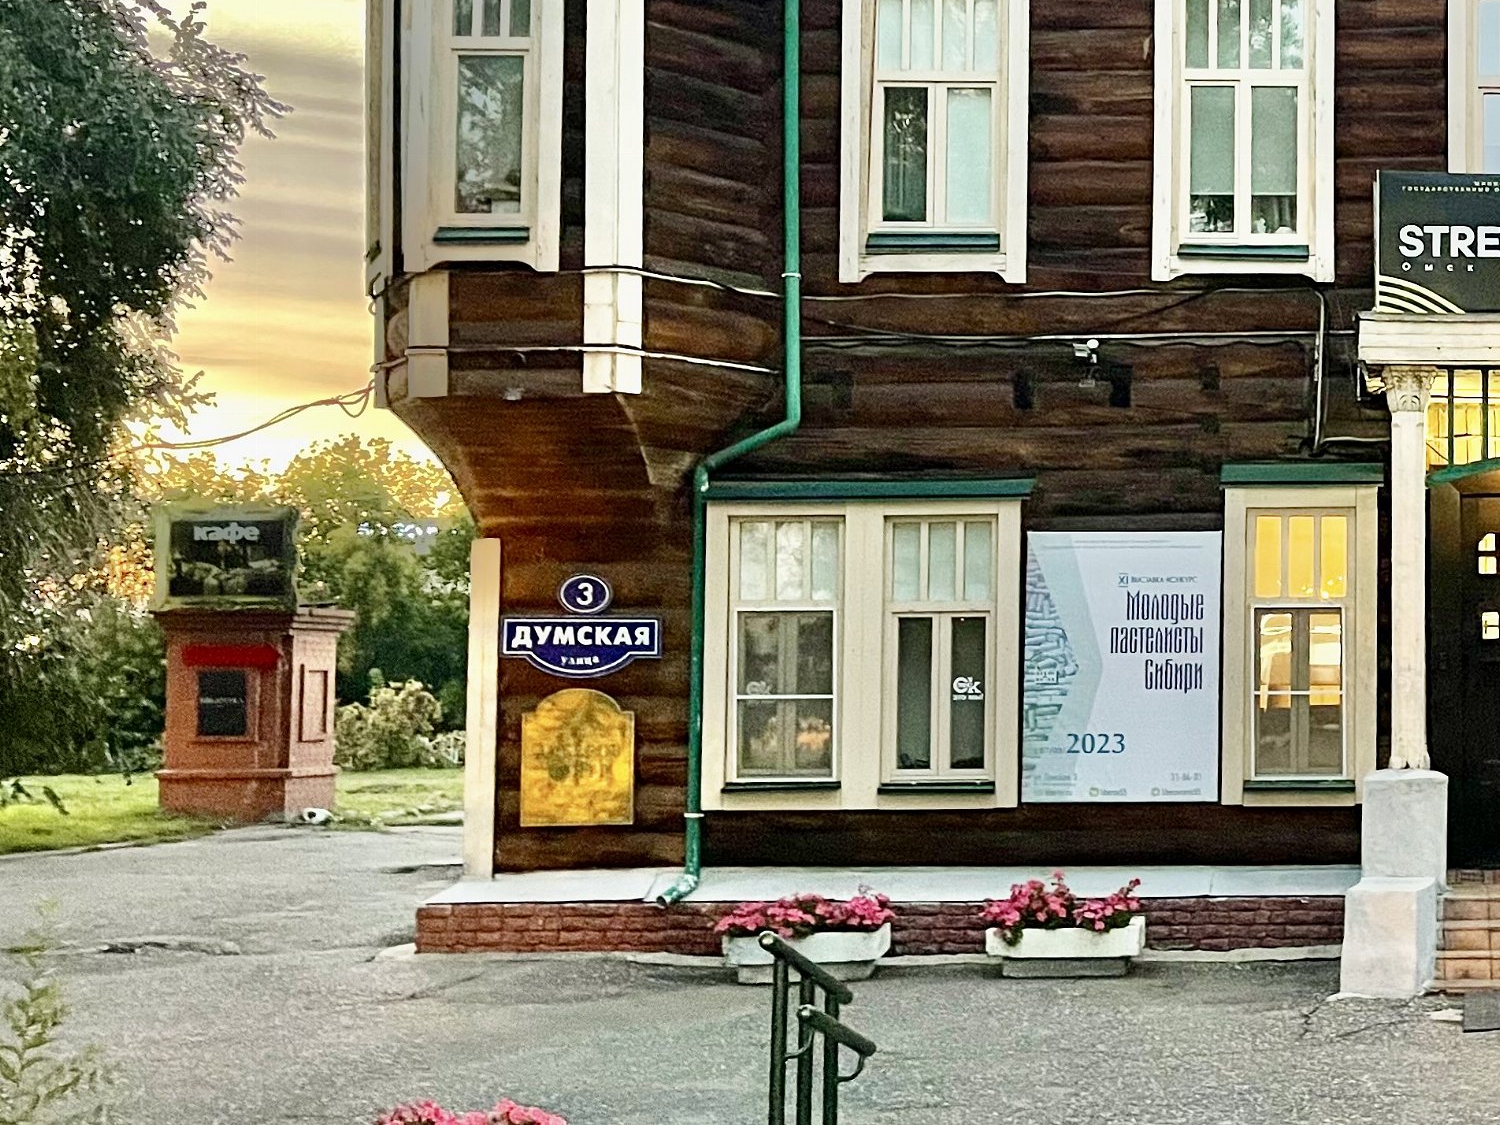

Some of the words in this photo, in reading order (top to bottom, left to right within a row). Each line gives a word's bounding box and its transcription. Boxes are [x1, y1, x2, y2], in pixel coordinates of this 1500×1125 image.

[1401, 262, 1474, 272] Омск
[193, 522, 260, 544] кафе
[576, 582, 594, 606] 3
[1126, 590, 1204, 625] Молодые
[511, 626, 650, 648] ДУМСКАЯ
[1110, 626, 1204, 654] пастелисты
[561, 655, 600, 666] улица
[1144, 659, 1203, 694] Сибири
[1066, 733, 1126, 754] 2023
